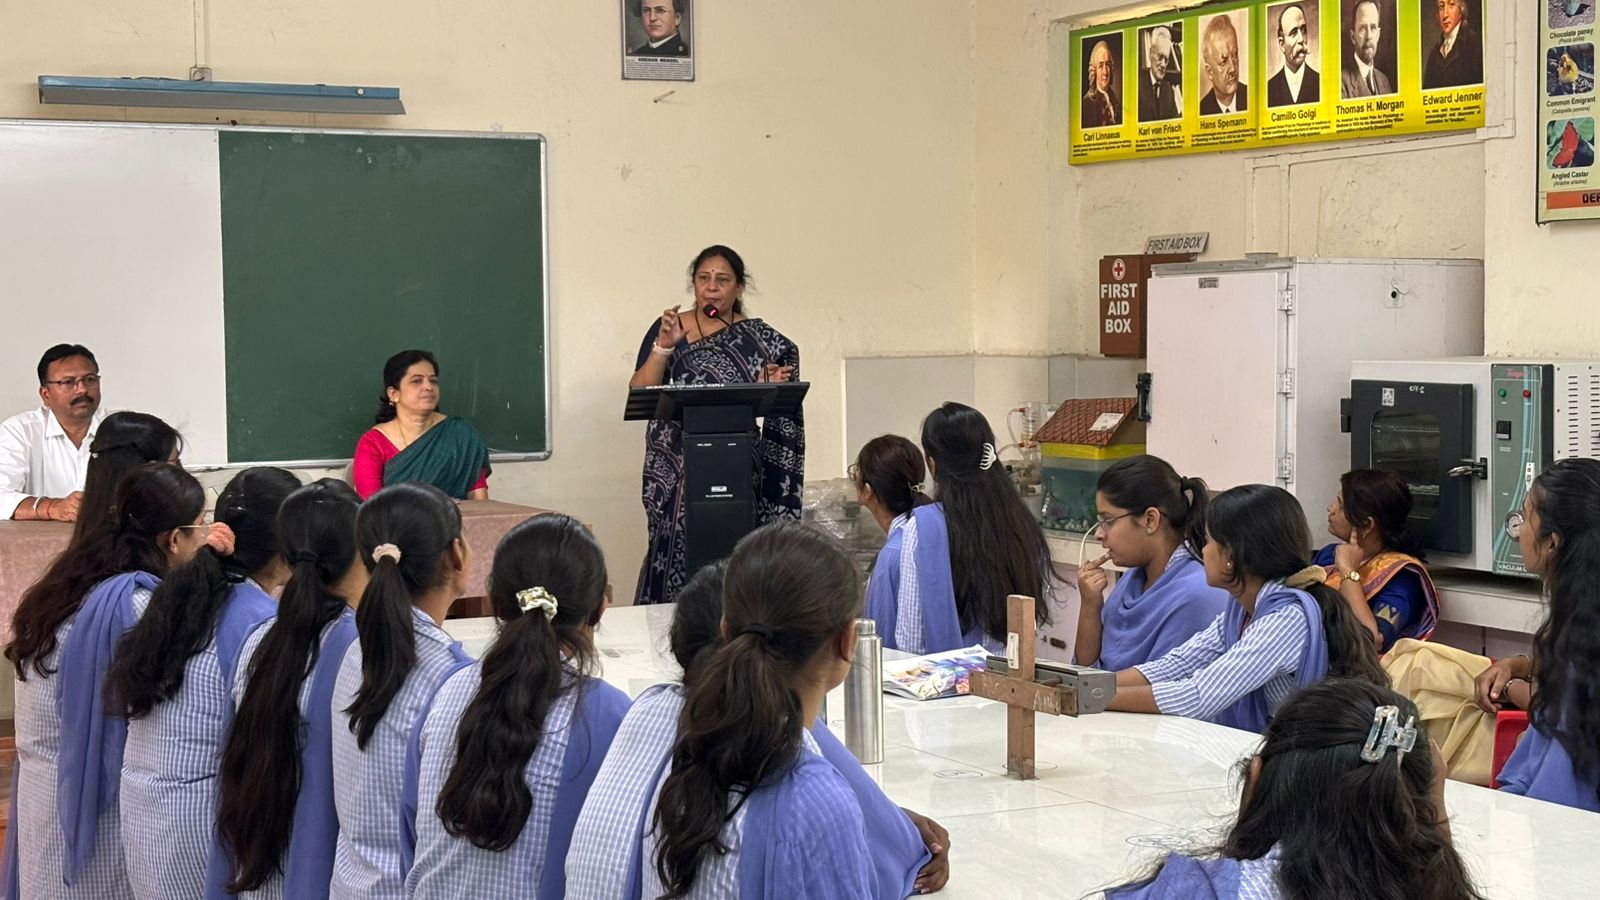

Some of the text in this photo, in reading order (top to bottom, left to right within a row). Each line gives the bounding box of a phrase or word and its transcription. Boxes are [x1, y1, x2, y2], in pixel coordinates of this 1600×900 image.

[1550, 28, 1594, 39] Chocolate pansy
[1423, 92, 1482, 105] Edward Jenner
[1546, 96, 1596, 107] Common Emigrant
[1336, 101, 1404, 115] Thomas H. Morgan
[1271, 108, 1316, 122] Camillo Golgi
[1139, 127, 1150, 136] Karl
[1163, 124, 1182, 134] Frisch
[1200, 118, 1247, 130] Hans Spemann
[1084, 132, 1120, 142] Carl Linnaeus
[1147, 236, 1203, 252] FIRST AID BOX
[1101, 283, 1138, 298] FIRST
[1108, 301, 1130, 315] AID
[1105, 319, 1132, 333] BOX
